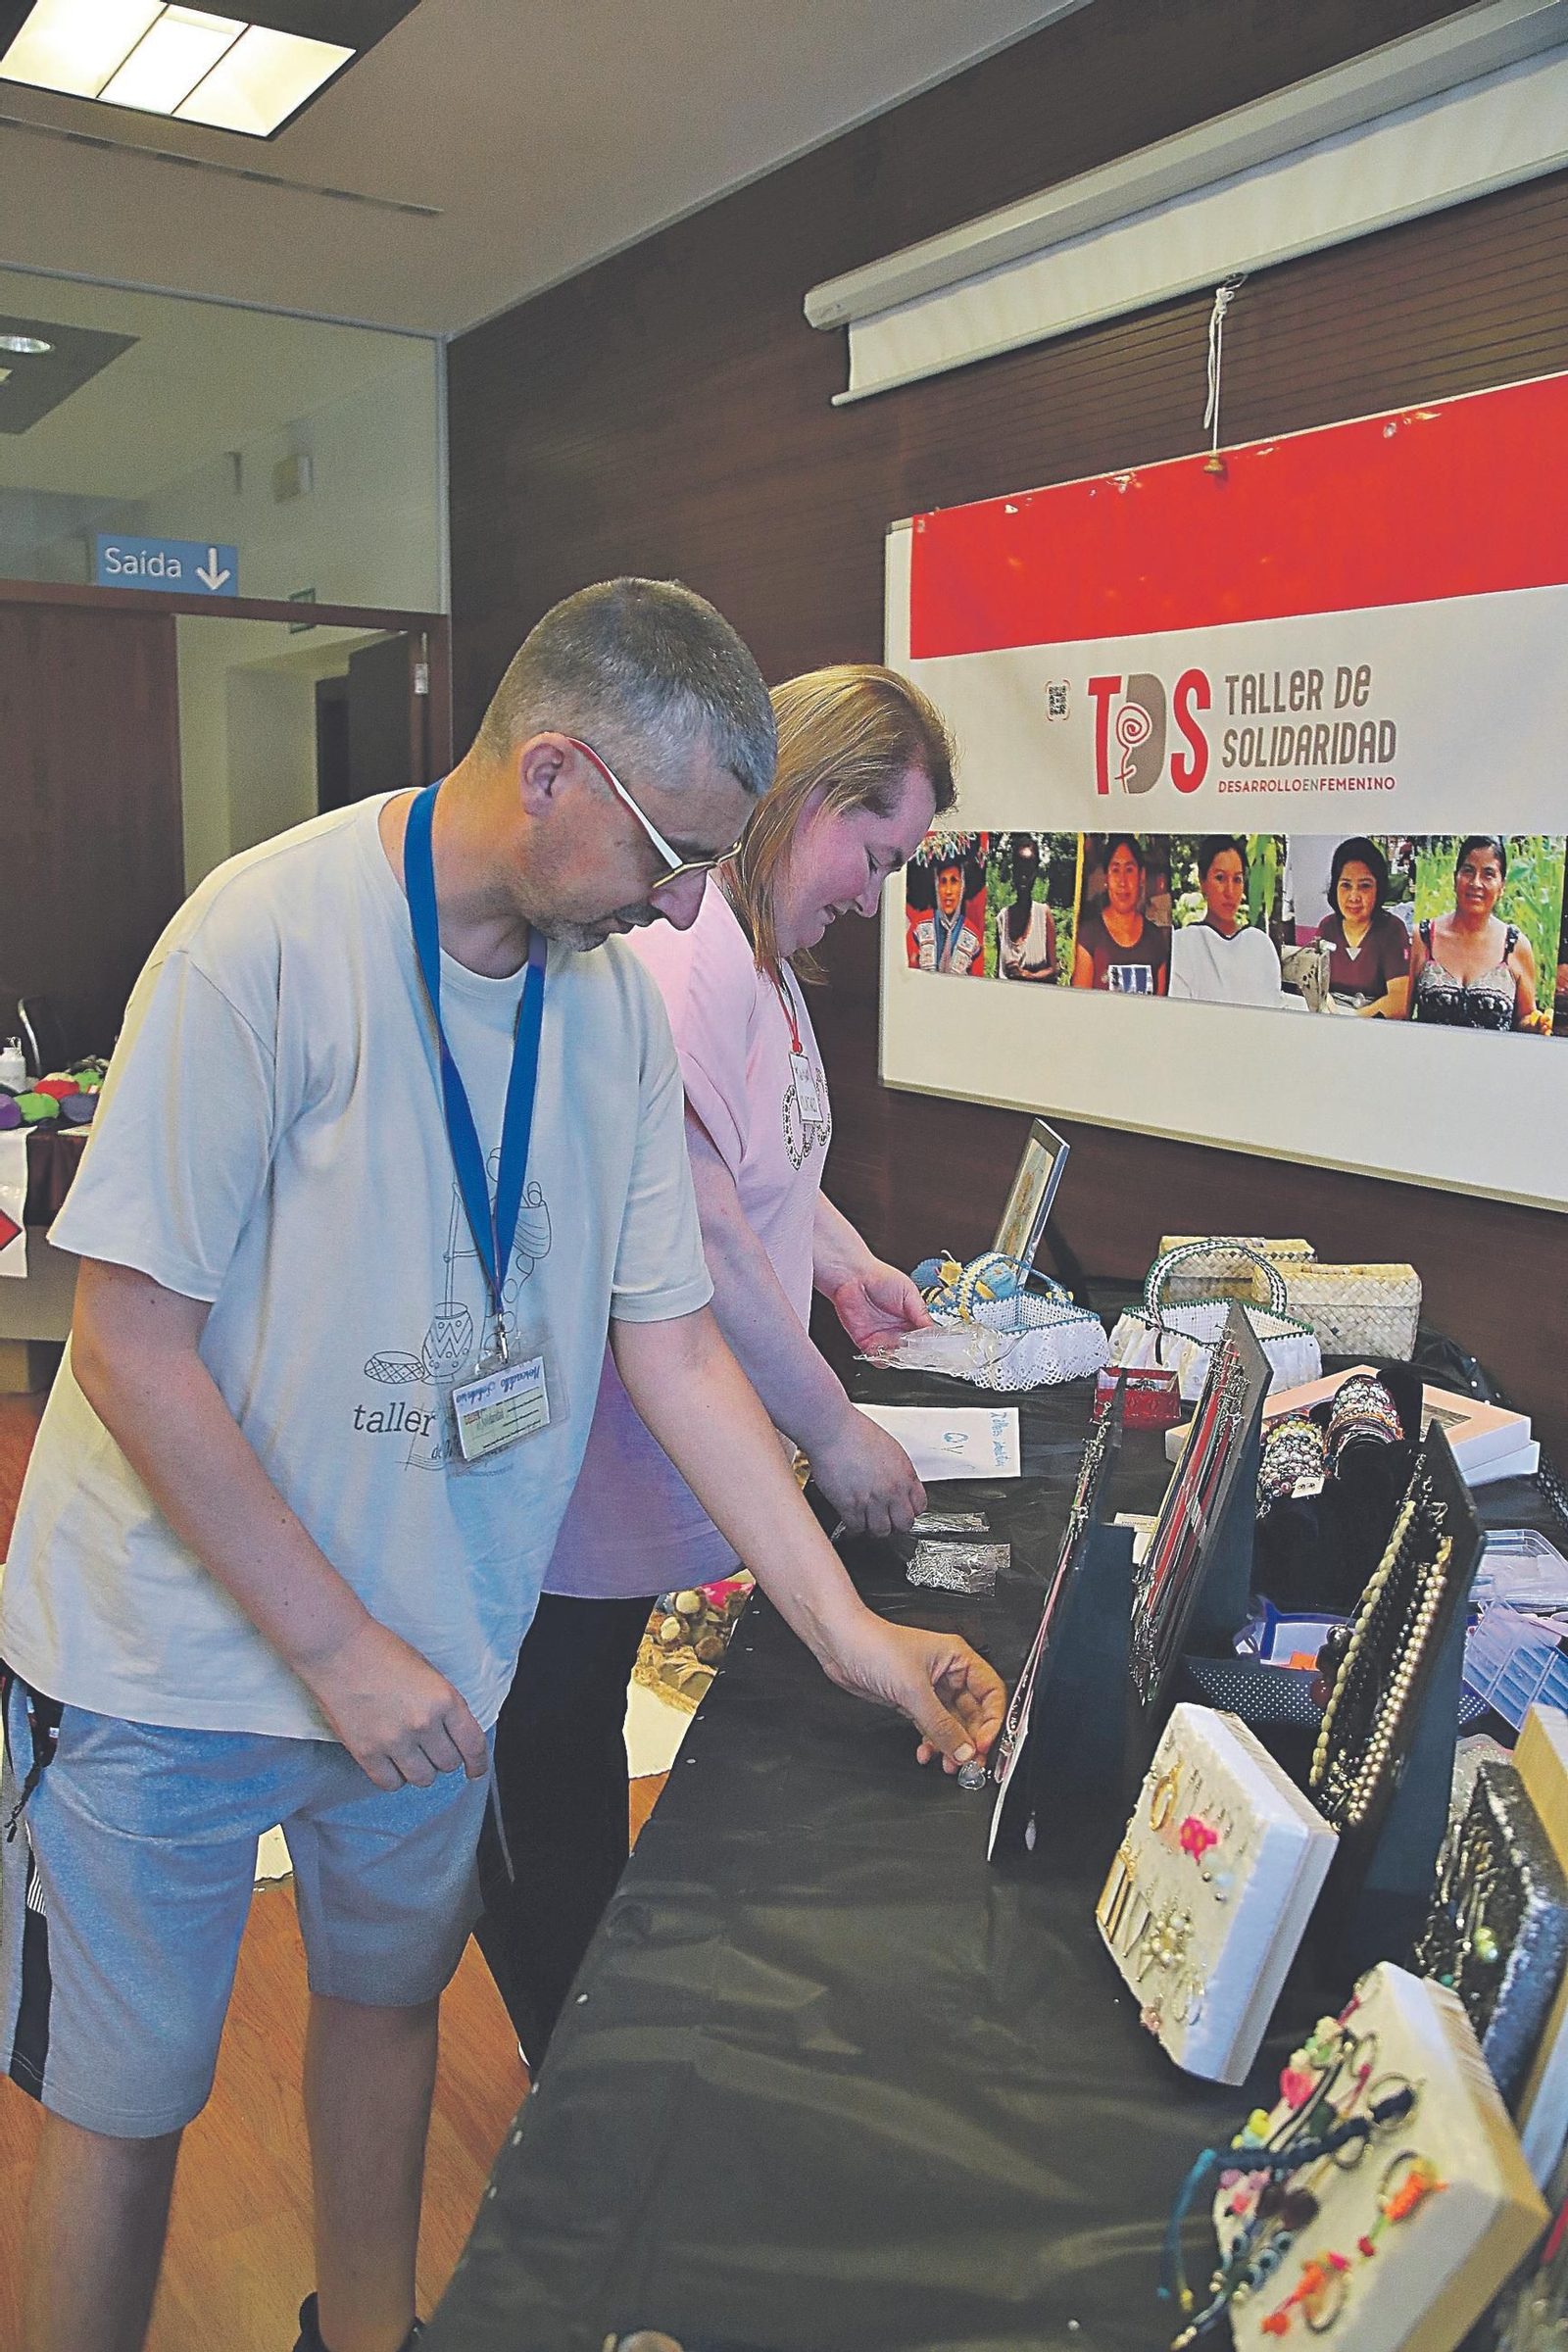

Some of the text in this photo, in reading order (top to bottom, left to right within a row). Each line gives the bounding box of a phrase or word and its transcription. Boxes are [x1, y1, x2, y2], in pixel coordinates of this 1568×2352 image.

[104, 546, 182, 579] Saída
[1088, 667, 1211, 796] TDS
[1221, 718, 1397, 769] SOLIDARIDAD
[354, 1401, 437, 1437] taller
